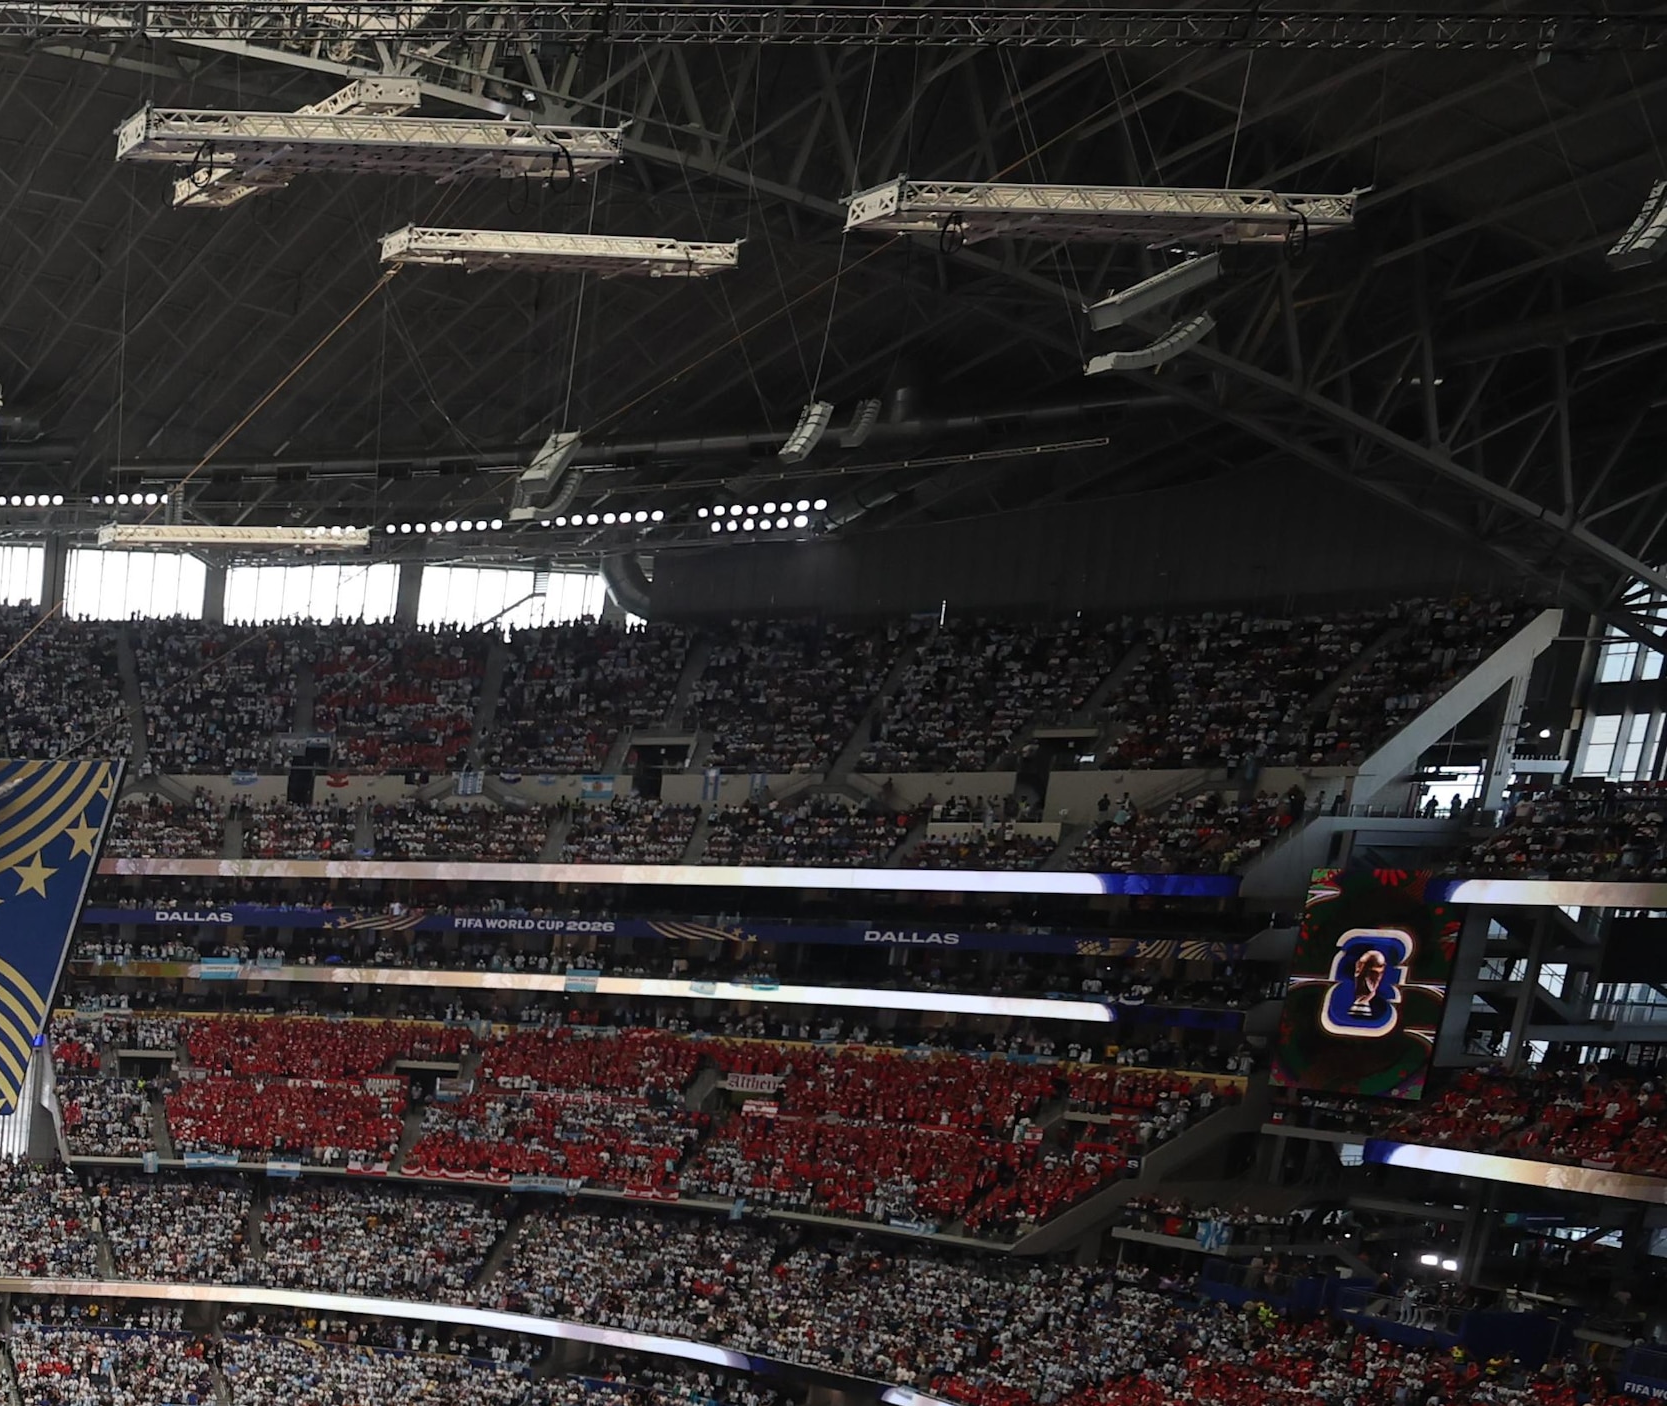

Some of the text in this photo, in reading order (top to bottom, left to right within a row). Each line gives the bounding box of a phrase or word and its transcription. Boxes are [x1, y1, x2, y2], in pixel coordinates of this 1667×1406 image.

[156, 911, 233, 922] DALLAS
[454, 917, 616, 932] FIFA WORLD CUP 2026
[864, 931, 959, 944] DALLAS
[1623, 1381, 1650, 1396] FIFA
